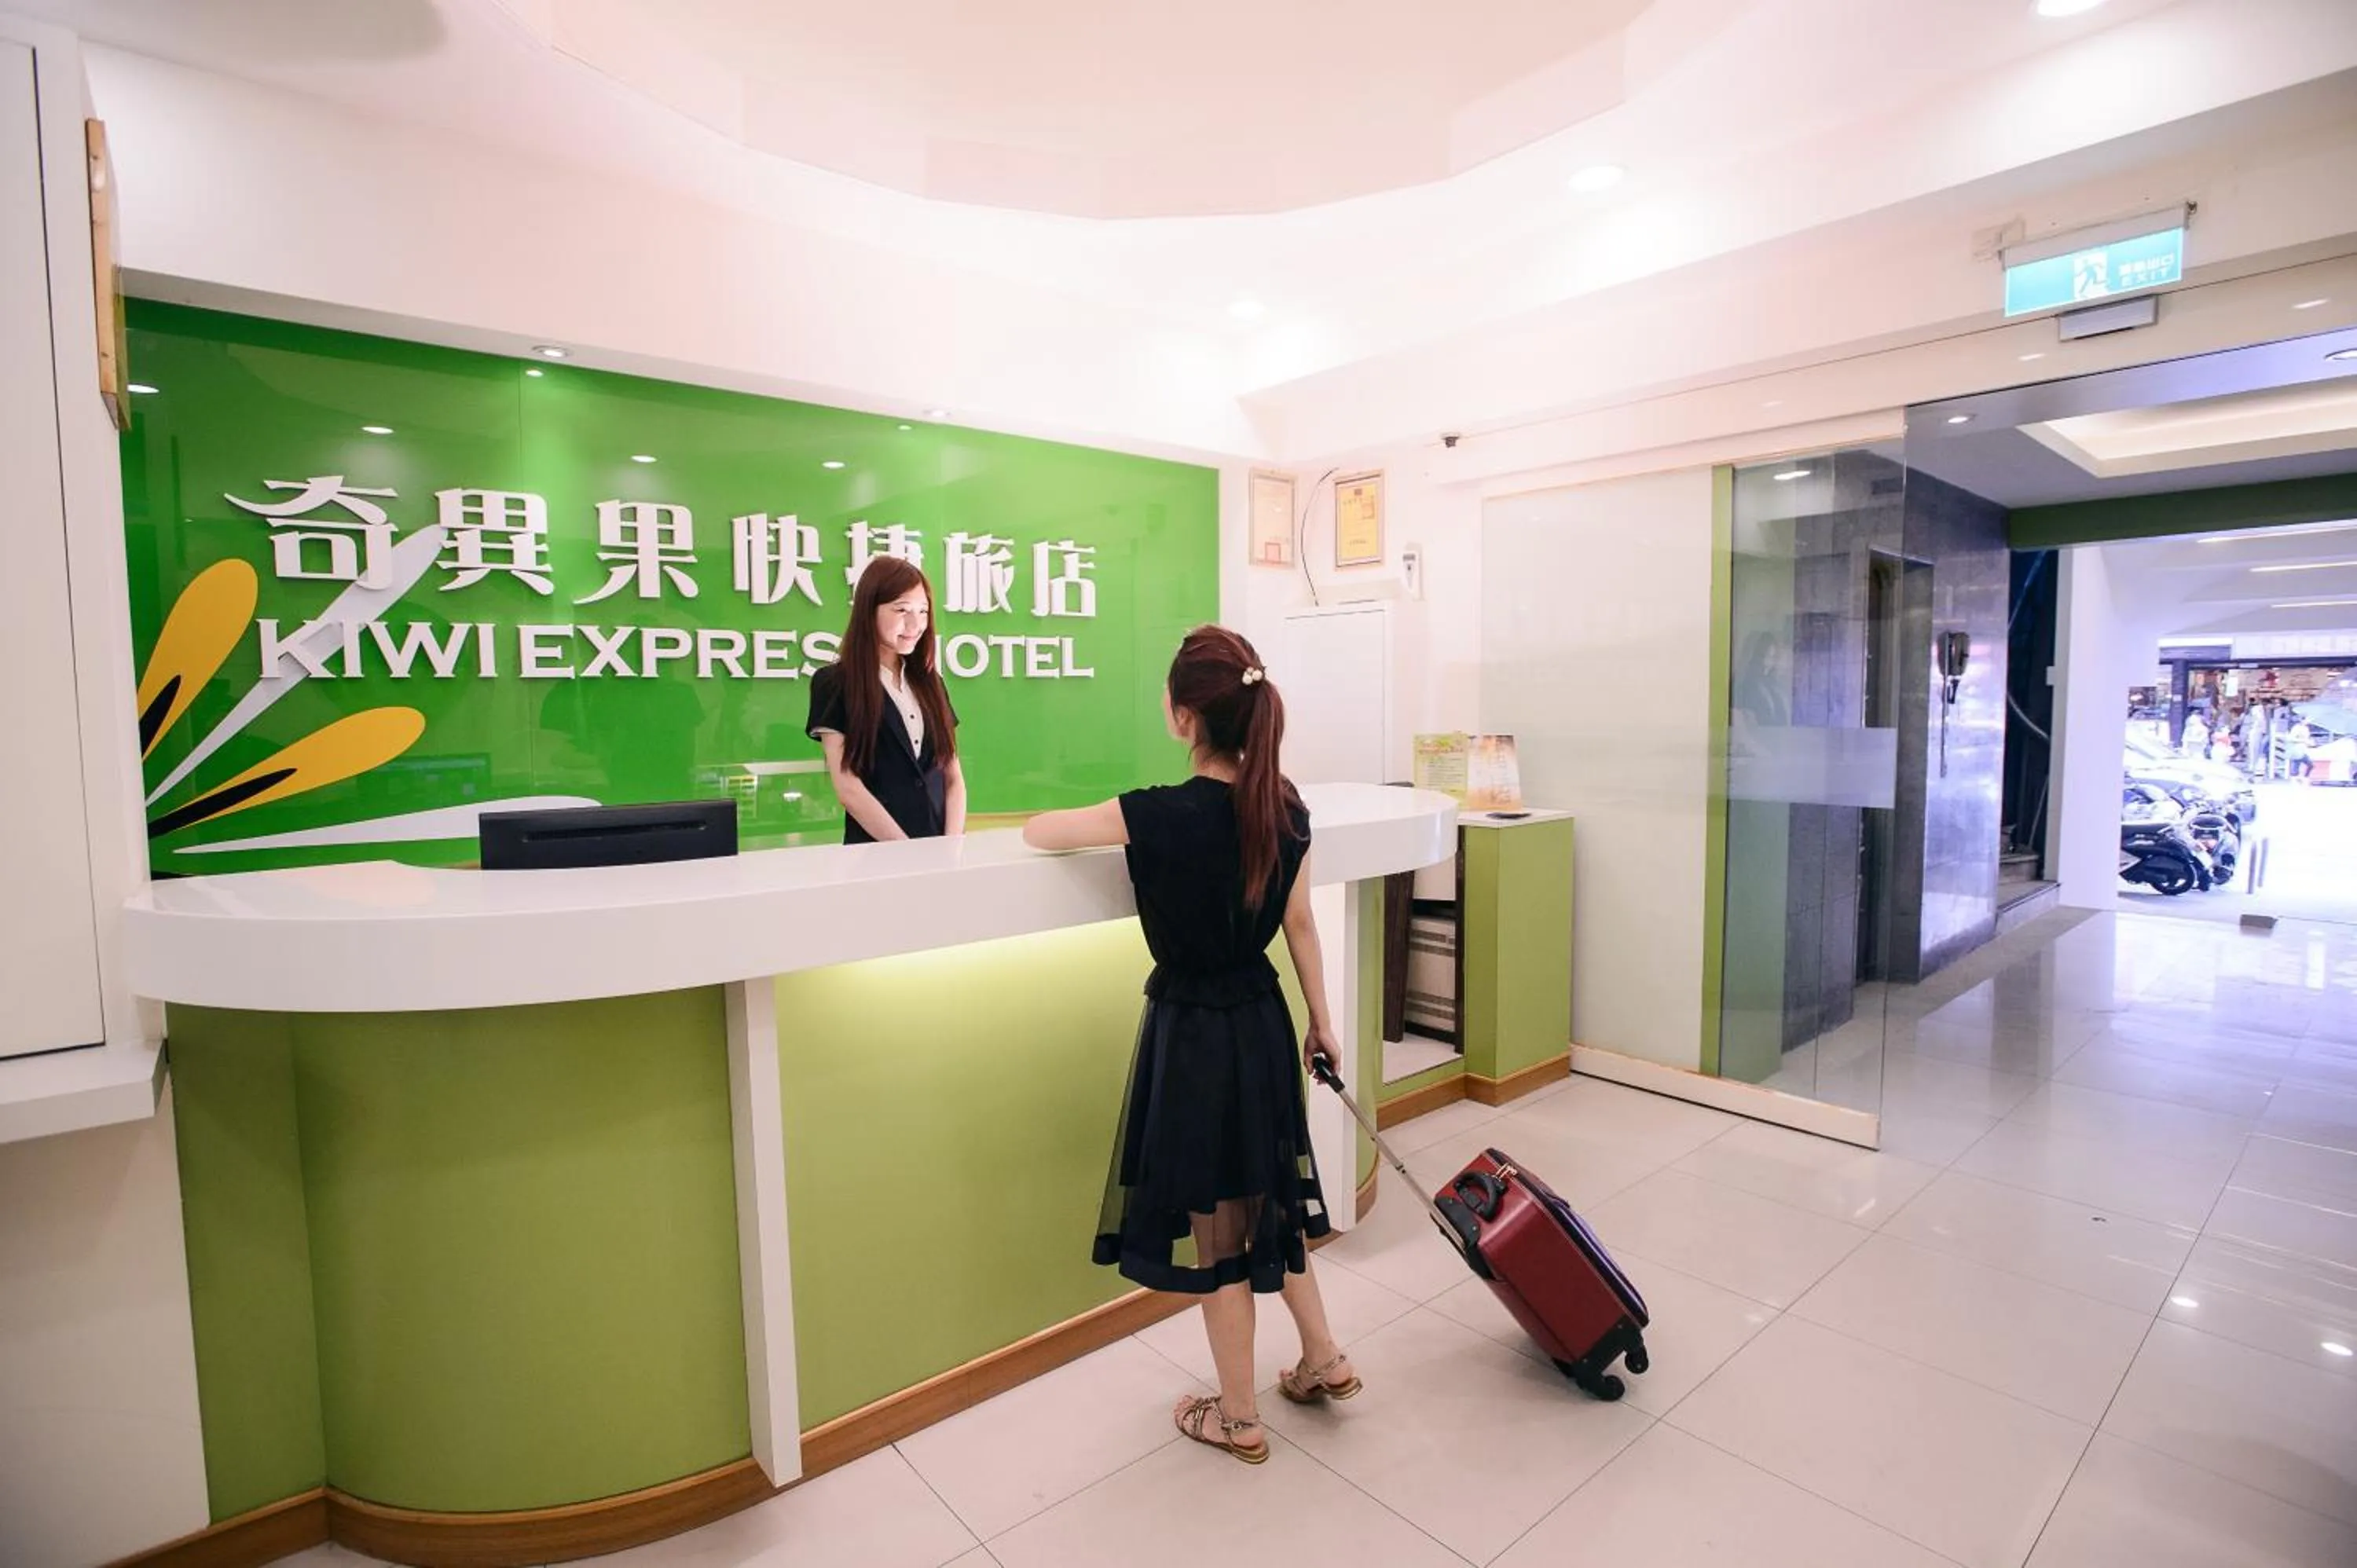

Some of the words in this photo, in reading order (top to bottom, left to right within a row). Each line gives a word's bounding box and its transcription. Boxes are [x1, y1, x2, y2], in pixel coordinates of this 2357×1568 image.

[2118, 252, 2175, 277] 出口
[2121, 266, 2169, 288] EXIT
[255, 617, 498, 680] KIWI
[516, 623, 844, 680] EXPRES
